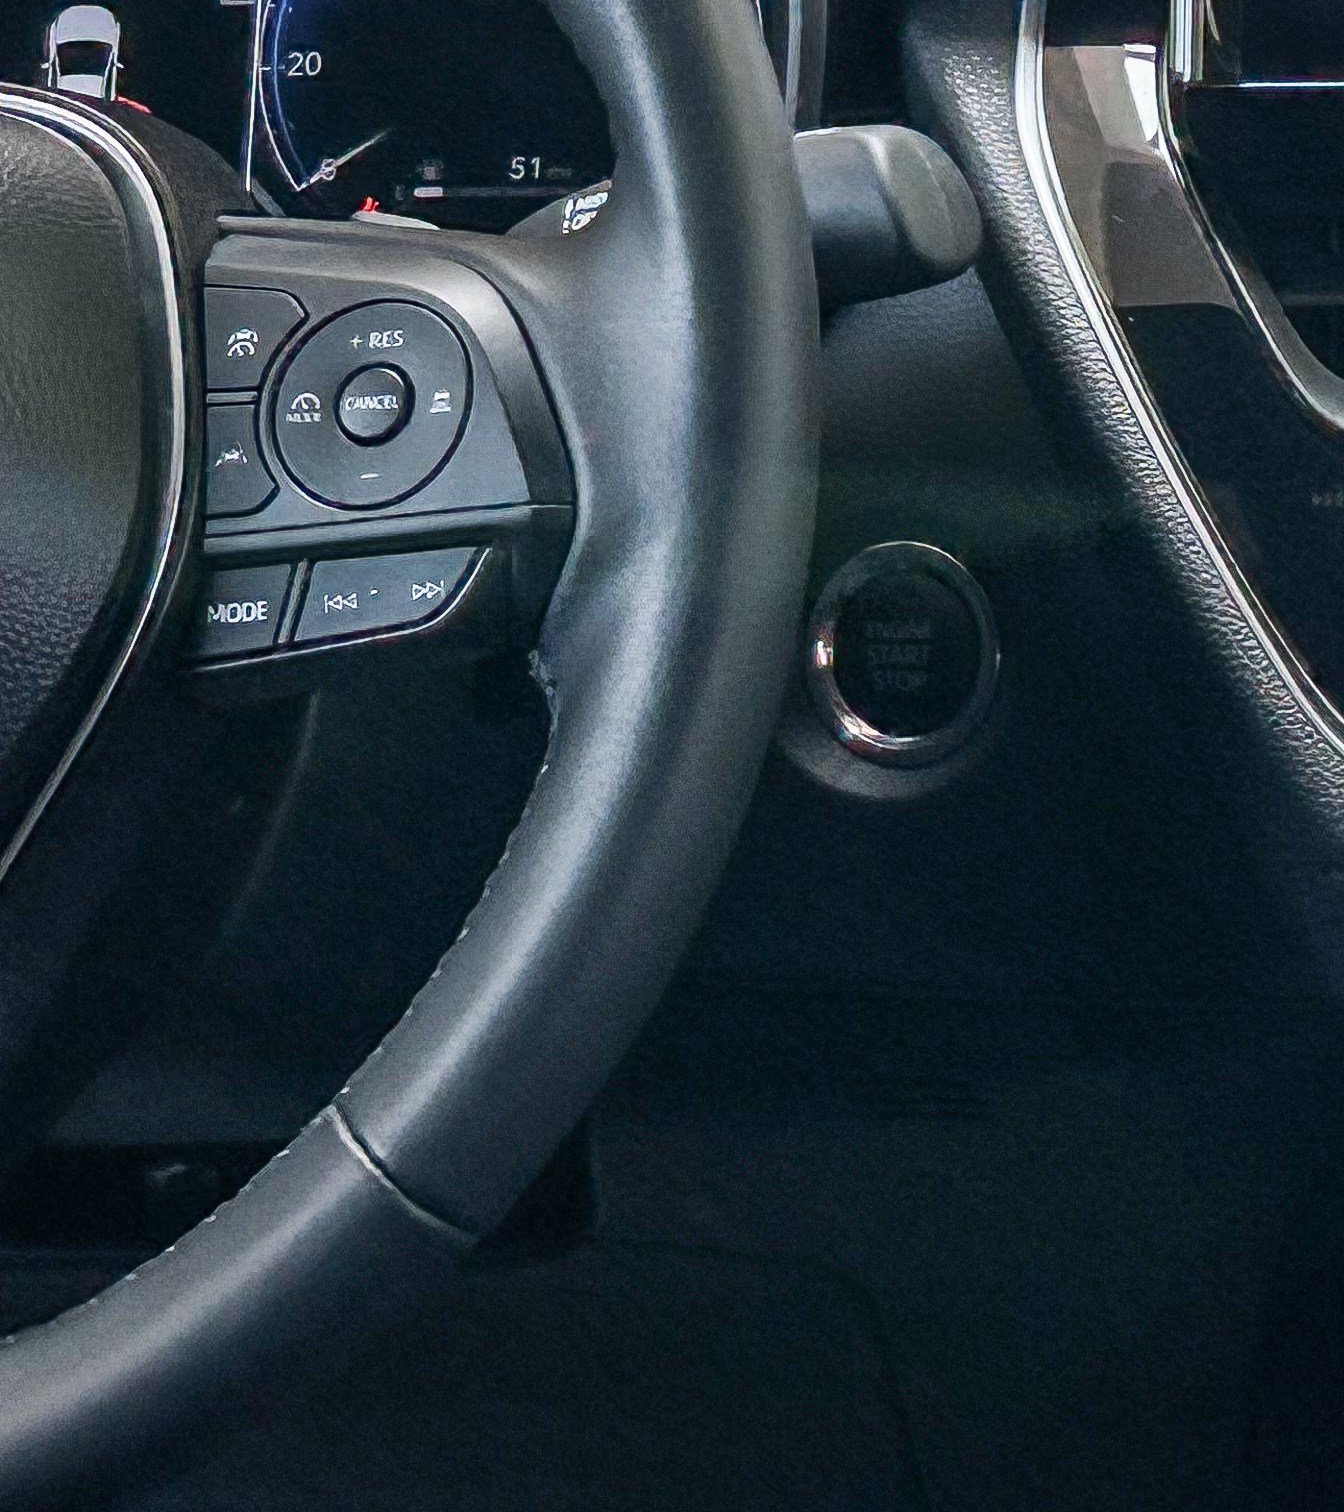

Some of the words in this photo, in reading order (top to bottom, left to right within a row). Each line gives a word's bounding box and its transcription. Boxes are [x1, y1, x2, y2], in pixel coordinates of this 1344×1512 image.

[287, 51, 322, 77] 20
[508, 156, 541, 180] 51
[368, 330, 405, 349] RES
[343, 393, 400, 411] CANCEL
[207, 600, 268, 623] MODE
